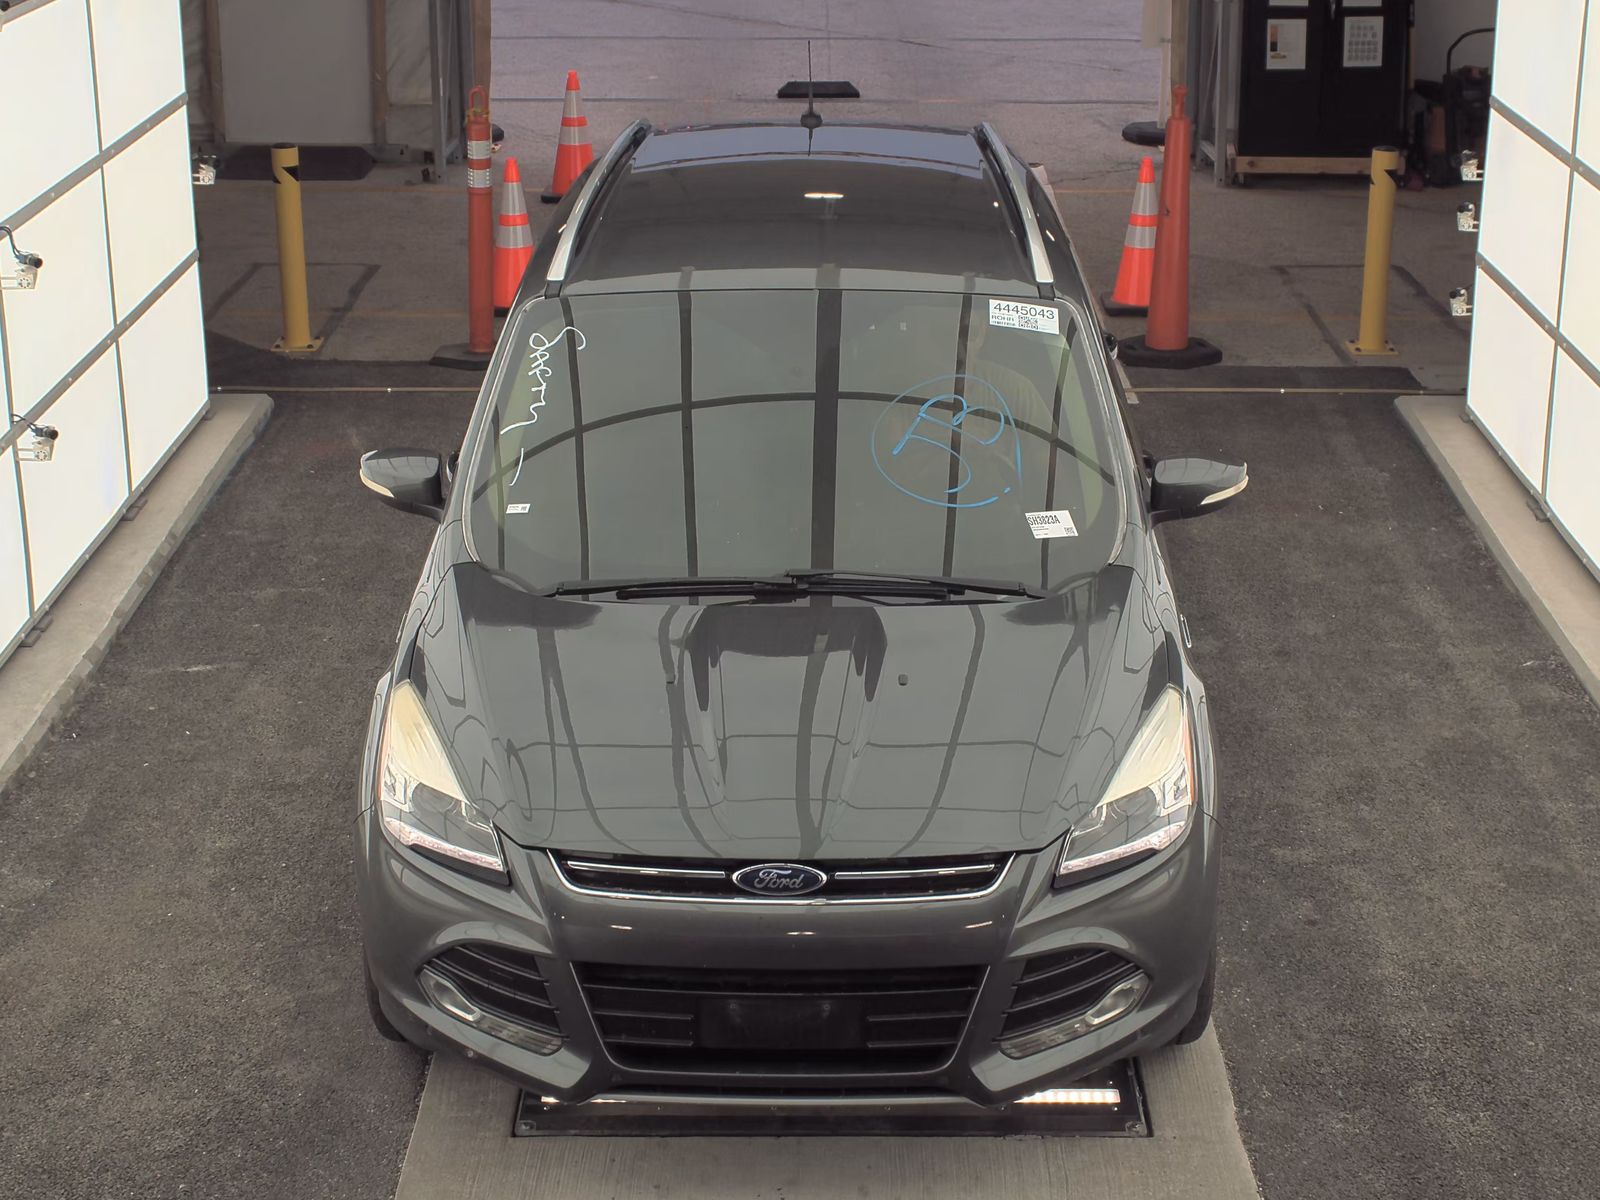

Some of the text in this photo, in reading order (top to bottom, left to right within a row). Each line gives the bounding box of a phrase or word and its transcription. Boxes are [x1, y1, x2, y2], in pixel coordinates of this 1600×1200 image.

[993, 303, 1055, 320] 4445043
[1027, 514, 1061, 526] SH3823A
[753, 868, 805, 889] Ford
